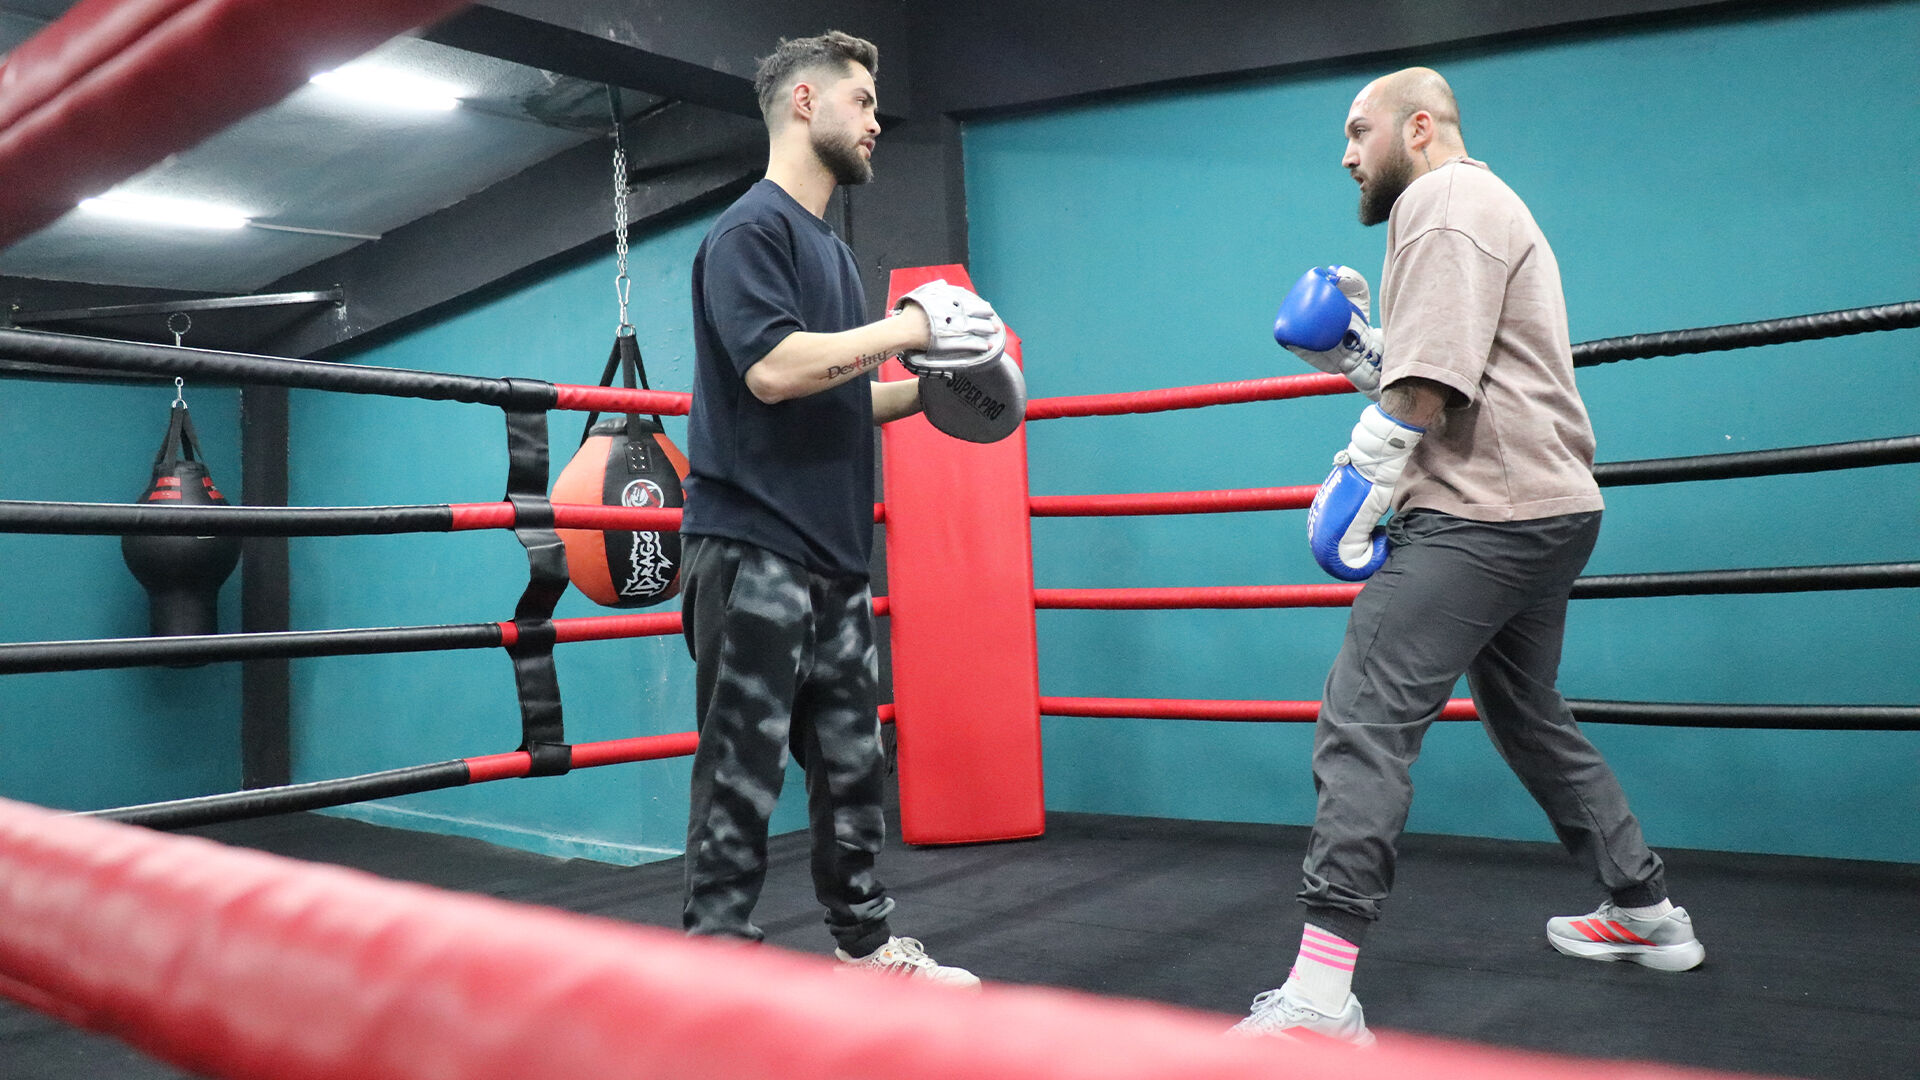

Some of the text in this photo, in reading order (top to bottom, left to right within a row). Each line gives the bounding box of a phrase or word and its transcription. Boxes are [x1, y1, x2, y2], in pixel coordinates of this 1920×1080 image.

[826, 350, 888, 379] Destiny
[946, 370, 1006, 421] SUPER PRO
[630, 531, 661, 591] DRAGO
